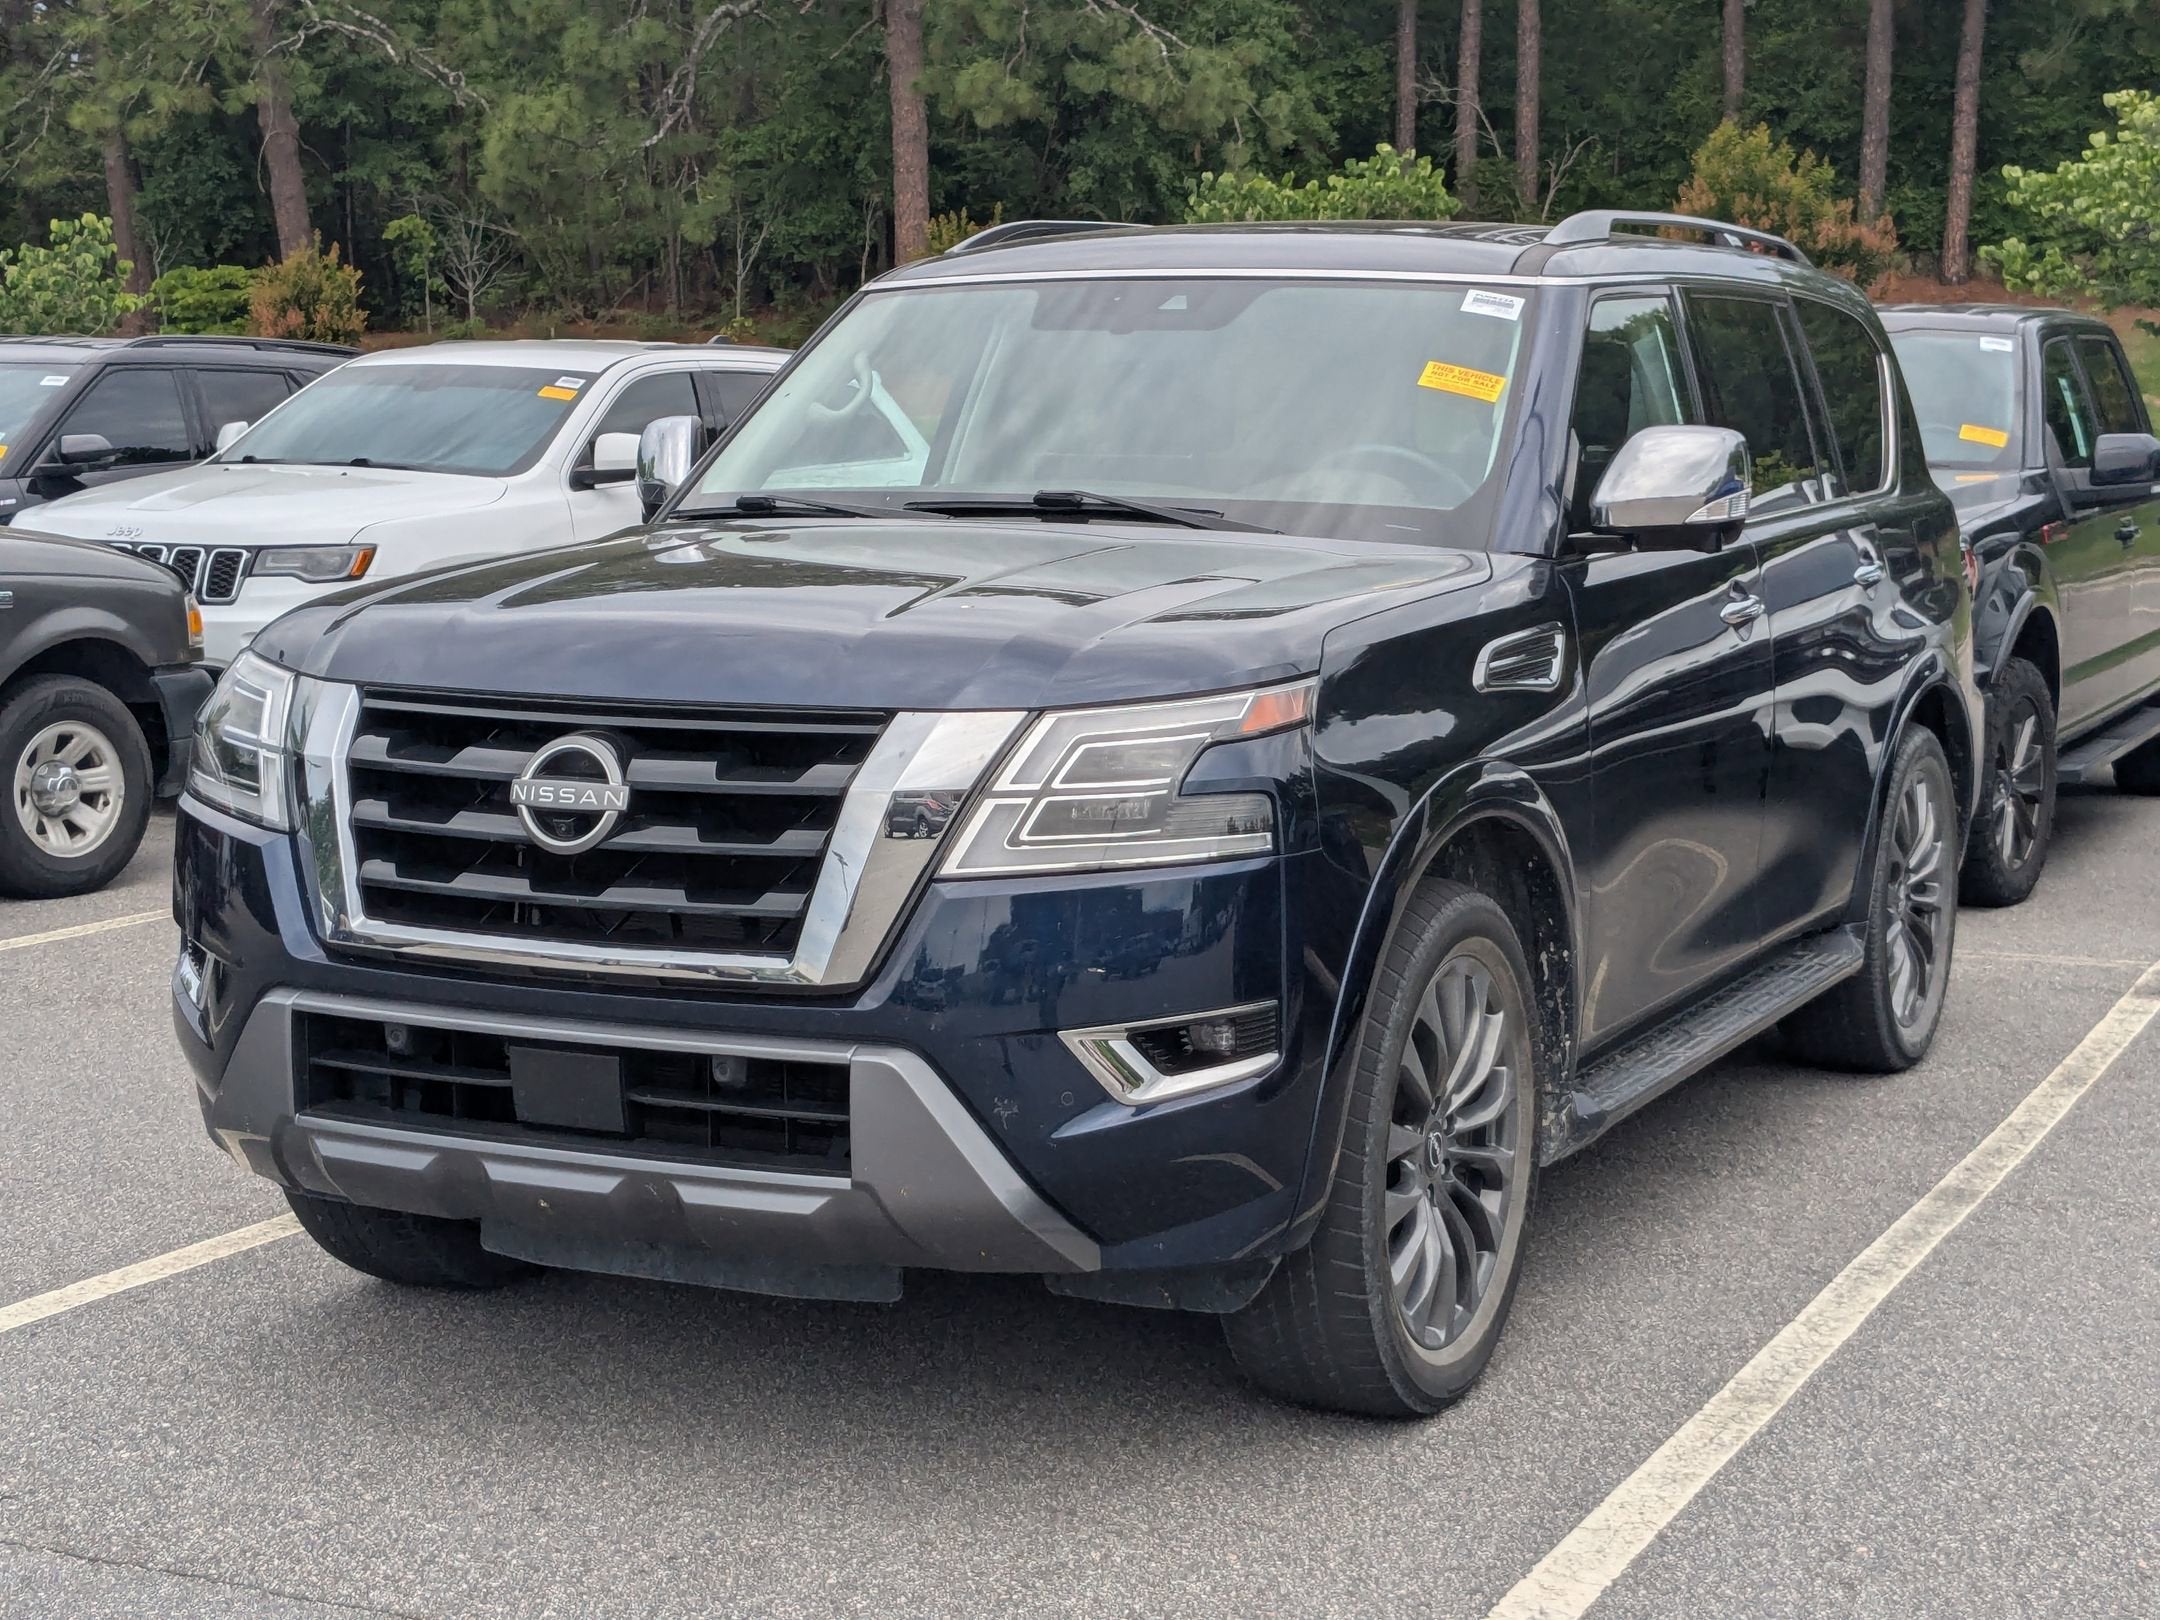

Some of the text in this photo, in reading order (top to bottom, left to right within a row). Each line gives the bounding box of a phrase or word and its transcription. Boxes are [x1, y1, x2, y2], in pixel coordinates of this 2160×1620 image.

[1430, 370, 1448, 378] NOT
[1451, 374, 1471, 382] FOR
[1473, 379, 1497, 389] SALE
[1432, 364, 1455, 374] THIS
[1457, 369, 1501, 384] VEHICLE
[106, 523, 144, 540] Jeep
[512, 784, 624, 807] NISSAN
